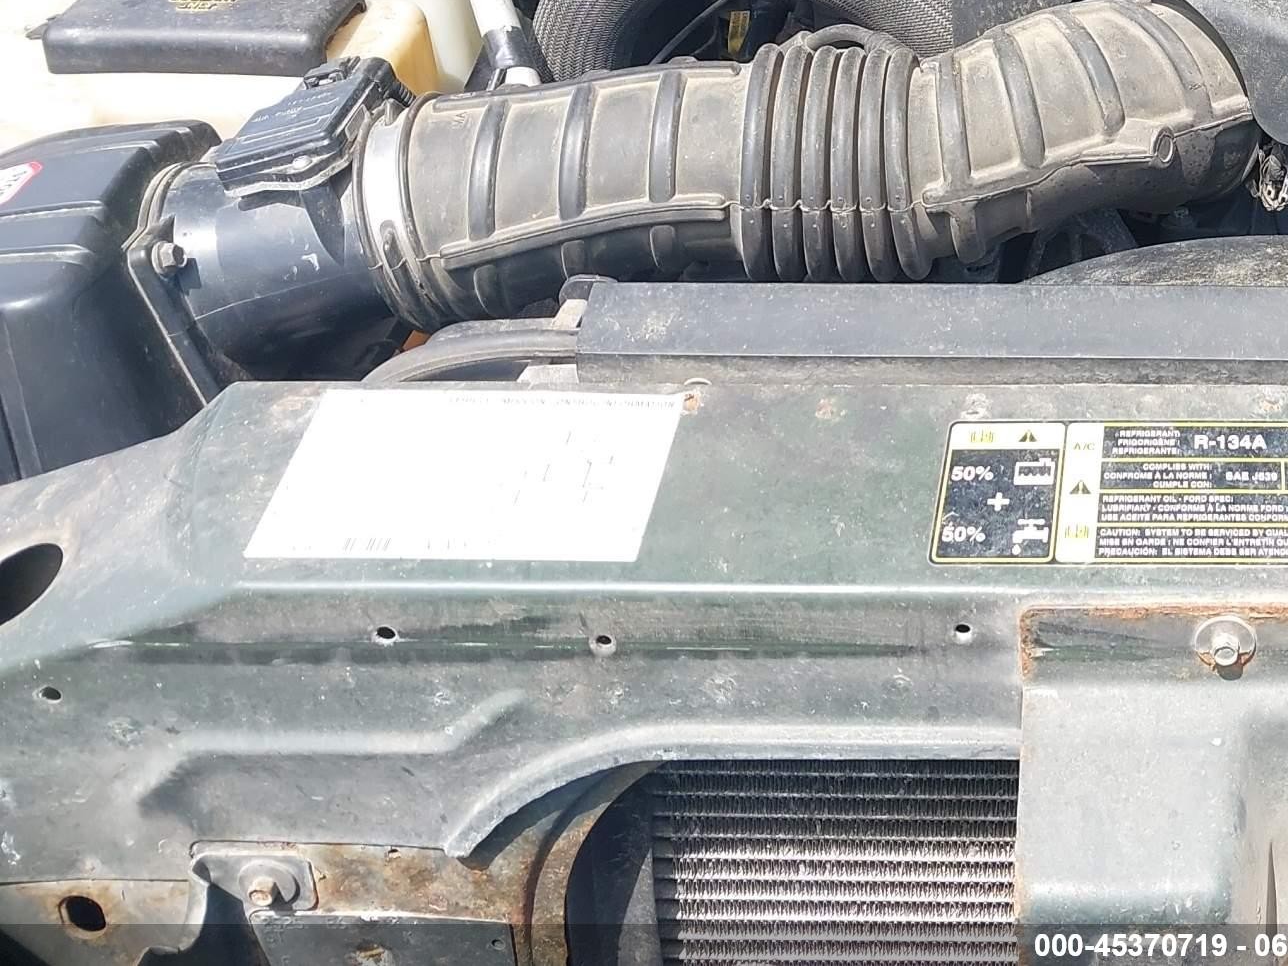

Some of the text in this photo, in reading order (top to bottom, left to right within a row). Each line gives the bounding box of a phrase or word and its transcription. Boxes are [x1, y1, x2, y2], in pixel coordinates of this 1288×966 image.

[1193, 434, 1268, 450] R-134A
[950, 465, 995, 481] 50%
[941, 525, 986, 543] 50%
